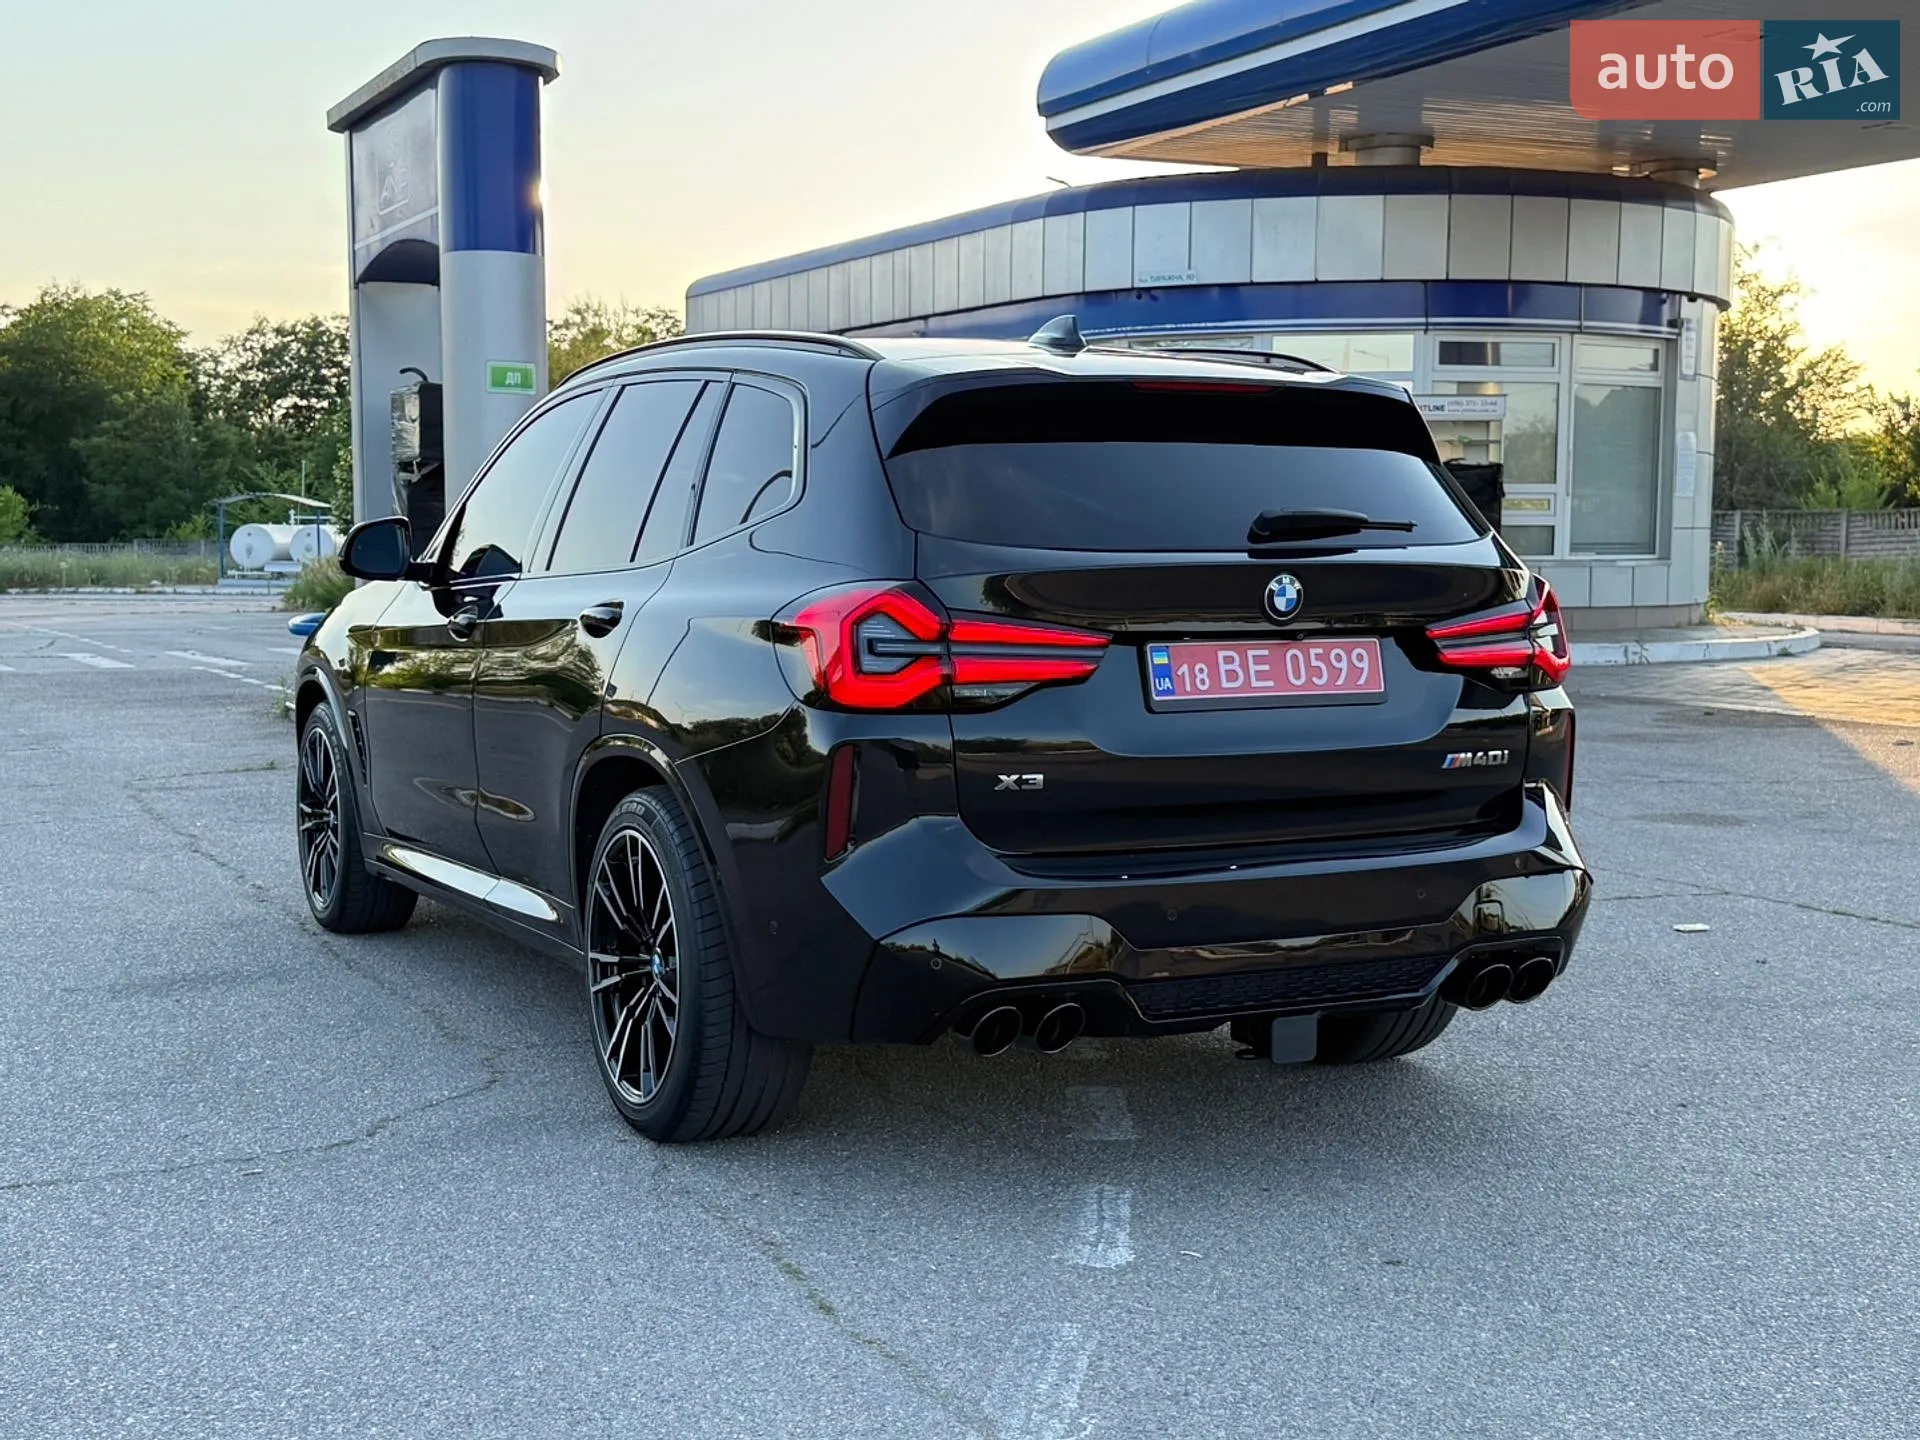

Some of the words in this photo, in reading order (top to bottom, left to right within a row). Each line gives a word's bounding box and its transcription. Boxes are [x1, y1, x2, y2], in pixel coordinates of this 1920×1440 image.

[1176, 662, 1210, 692] 18
[1216, 649, 1275, 689] BE
[1284, 647, 1369, 687] 0599
[1154, 677, 1173, 691] UA
[994, 774, 1044, 790] X3
